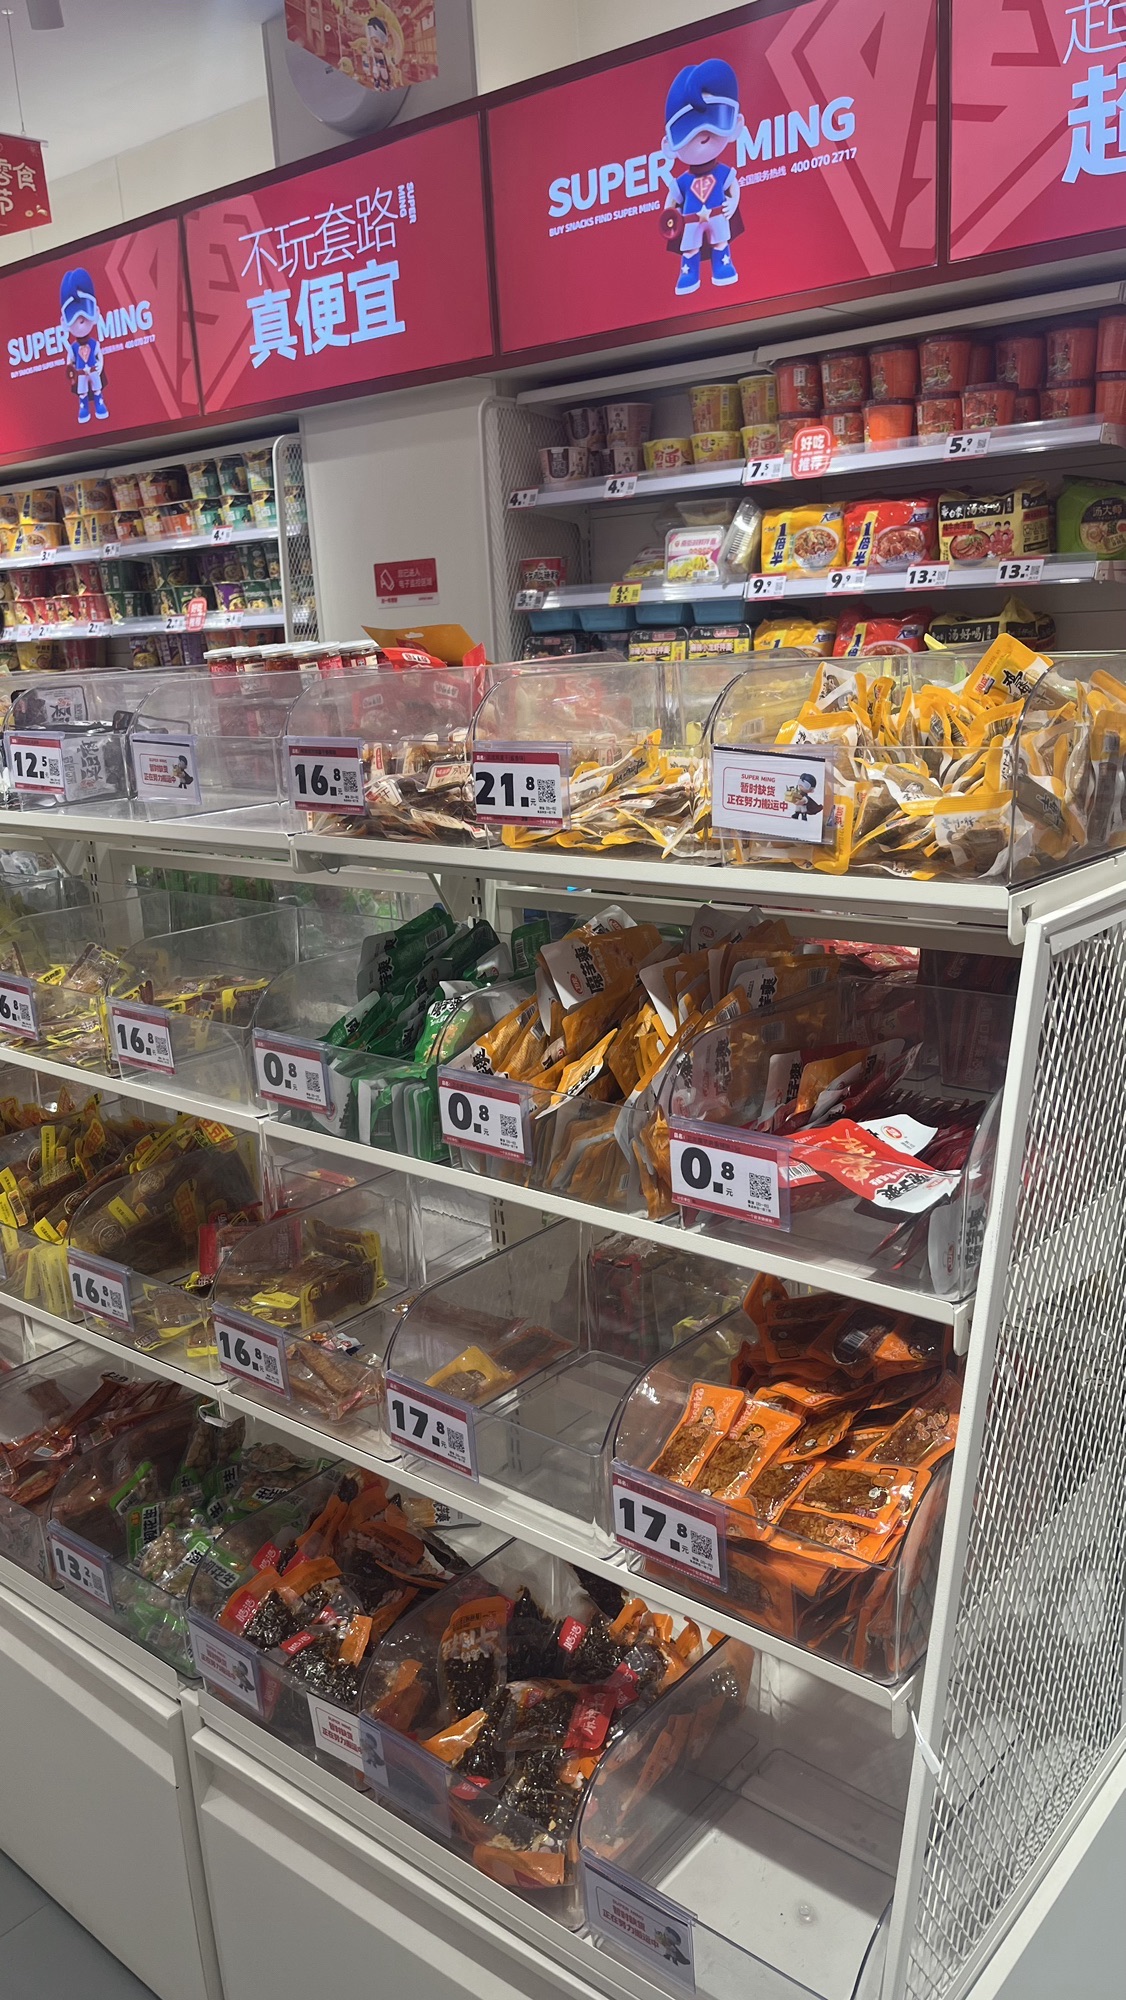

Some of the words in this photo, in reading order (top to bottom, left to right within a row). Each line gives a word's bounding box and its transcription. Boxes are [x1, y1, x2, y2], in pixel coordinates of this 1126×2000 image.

[549, 151, 676, 217] SUPER
[736, 96, 856, 168] MING
[790, 159, 810, 174] 400
[811, 154, 830, 169] 070
[831, 147, 857, 163] 2717
[398, 184, 407, 218] MING
[406, 181, 417, 225] SUPER
[549, 224, 565, 237] BUY
[565, 218, 594, 233] SNACKS
[595, 213, 613, 226] FIND
[613, 206, 638, 221] SUPER
[639, 200, 661, 215] MING
[238, 186, 399, 286] 不玩套路
[246, 258, 406, 369] 真便宜
[7, 325, 72, 366] SUPER
[97, 300, 154, 342] MING
[800, 434, 825, 451] 好吃
[950, 437, 973, 453] 5.9
[751, 462, 769, 477] 7.5
[509, 492, 528, 506] 4.9
[607, 480, 625, 494] 4.9
[753, 578, 772, 595] 9.9
[831, 573, 851, 589] 9.9
[909, 570, 937, 585] 13.2
[999, 564, 1029, 579] 13.2
[948, 627, 982, 640] 汤好喝
[14, 751, 48, 779] 12.5
[295, 764, 342, 797] 16.8
[741, 773, 759, 781] SUPER
[761, 775, 776, 783] MING
[475, 771, 536, 808] 21.8
[727, 793, 789, 812] 正在努力搬运中
[740, 782, 776, 797] 暂时缺货
[574, 945, 605, 995] 魔芋爽
[117, 1023, 154, 1056] 16.8
[263, 1052, 298, 1090] 0.8
[448, 1092, 490, 1134] 0.8
[680, 1146, 735, 1194] 0.8
[726, 1188, 734, 1197] 元
[72, 1272, 109, 1308] 16.8
[219, 1330, 262, 1371] 16.8
[392, 1399, 445, 1447] 17.8
[619, 1497, 688, 1552] 17.8
[55, 1547, 91, 1587] 13.2
